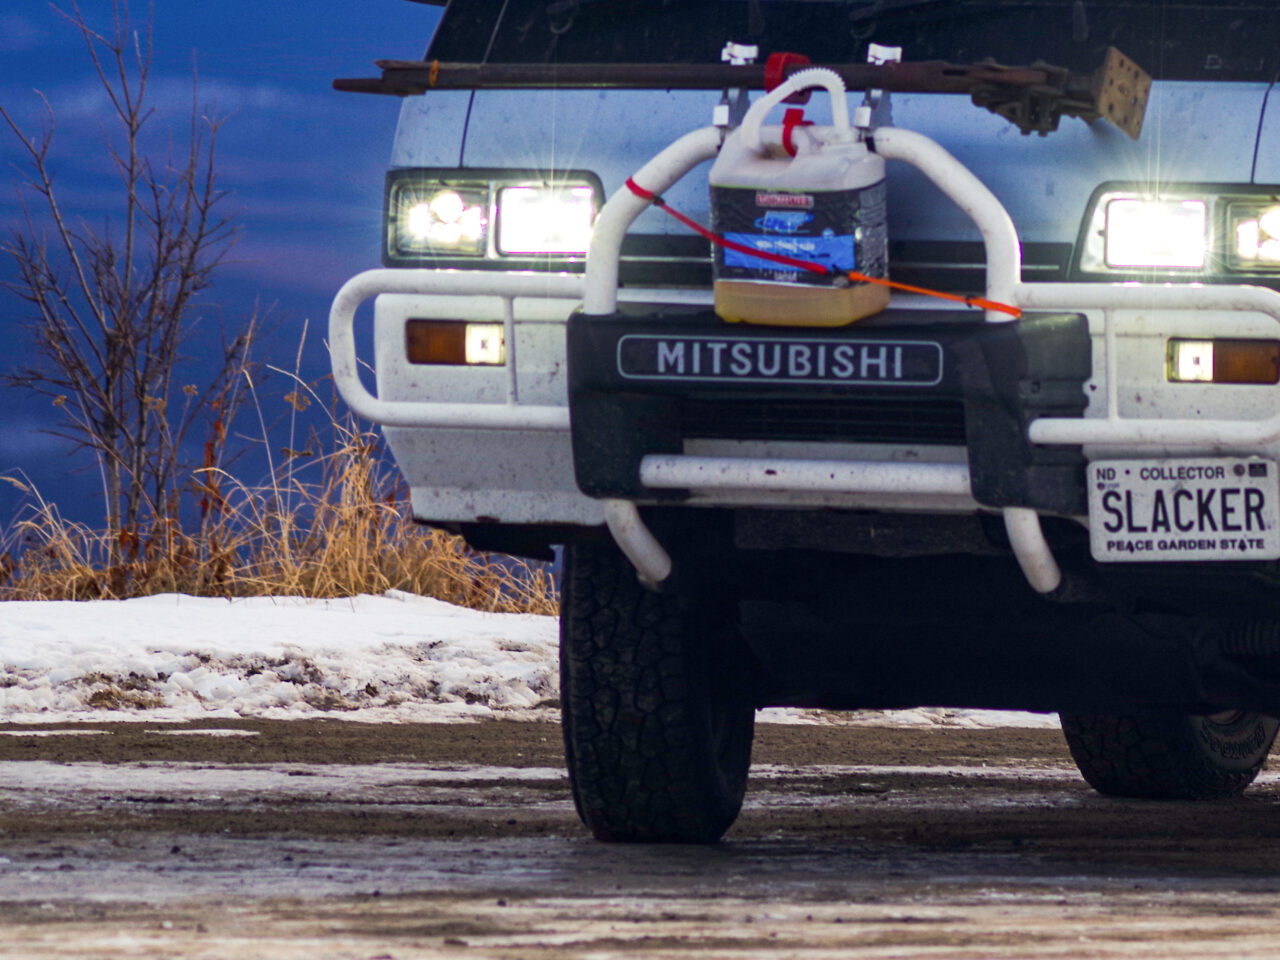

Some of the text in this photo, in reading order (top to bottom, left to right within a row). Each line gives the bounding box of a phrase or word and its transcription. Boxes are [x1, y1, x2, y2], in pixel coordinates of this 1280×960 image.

[656, 341, 903, 379] MITSUBISHI
[1096, 466, 1225, 481] ND COLLECTOR
[1102, 488, 1269, 533] SLACKER
[1107, 538, 1265, 552] PEACE GARDEN STATE
